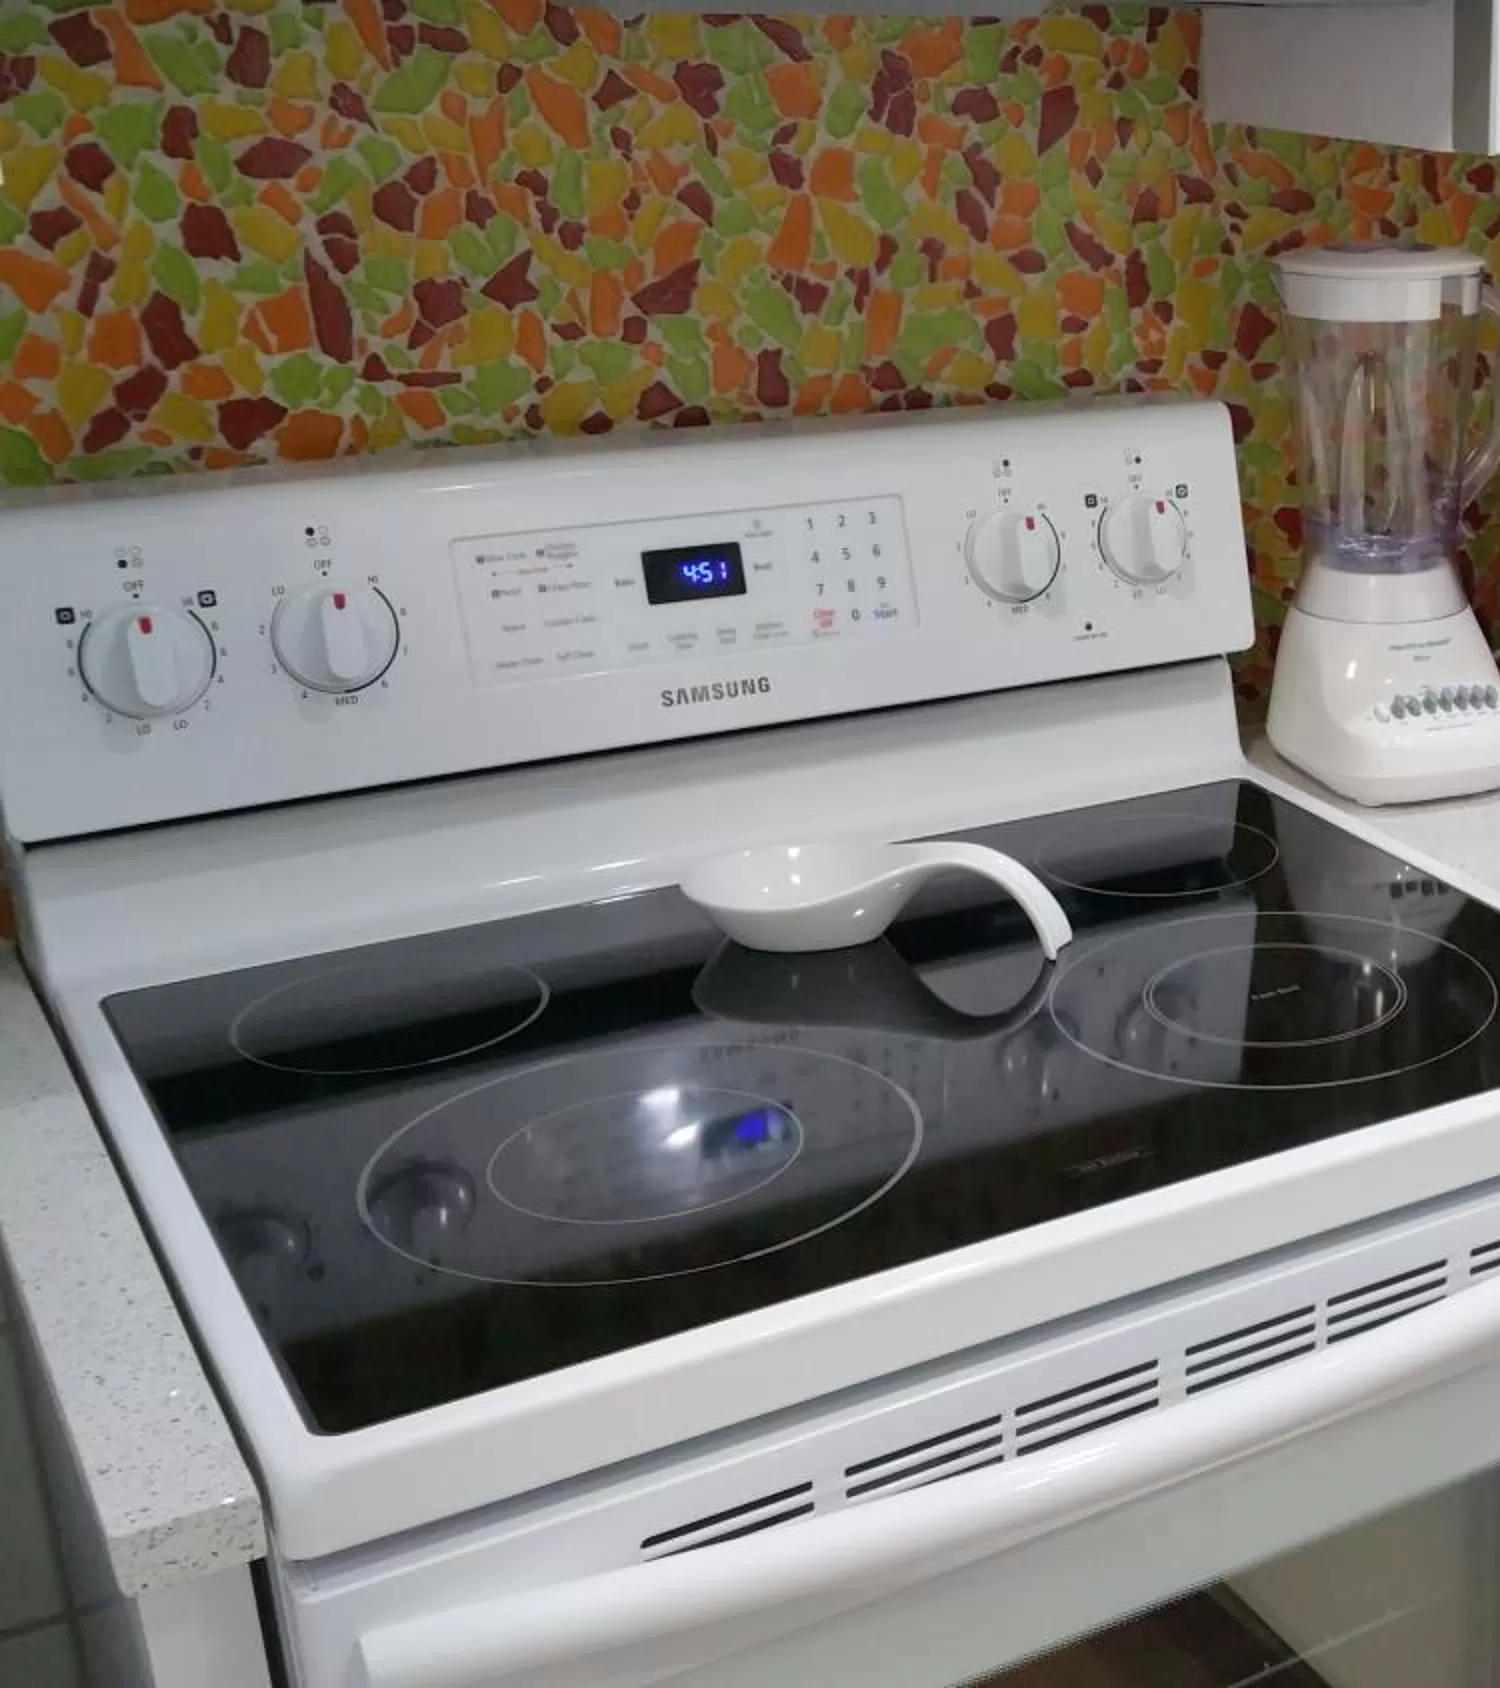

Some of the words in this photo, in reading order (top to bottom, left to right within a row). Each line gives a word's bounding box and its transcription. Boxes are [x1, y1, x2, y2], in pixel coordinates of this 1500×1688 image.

[807, 516, 814, 531] 1
[838, 514, 847, 528] 2
[867, 511, 877, 525] 3
[810, 549, 820, 564] 4
[840, 547, 851, 561] 5
[872, 543, 881, 559] 6
[847, 579, 856, 593] 8
[876, 575, 888, 590] 9
[851, 607, 861, 621] 0
[660, 675, 773, 709] SAMSUNG
